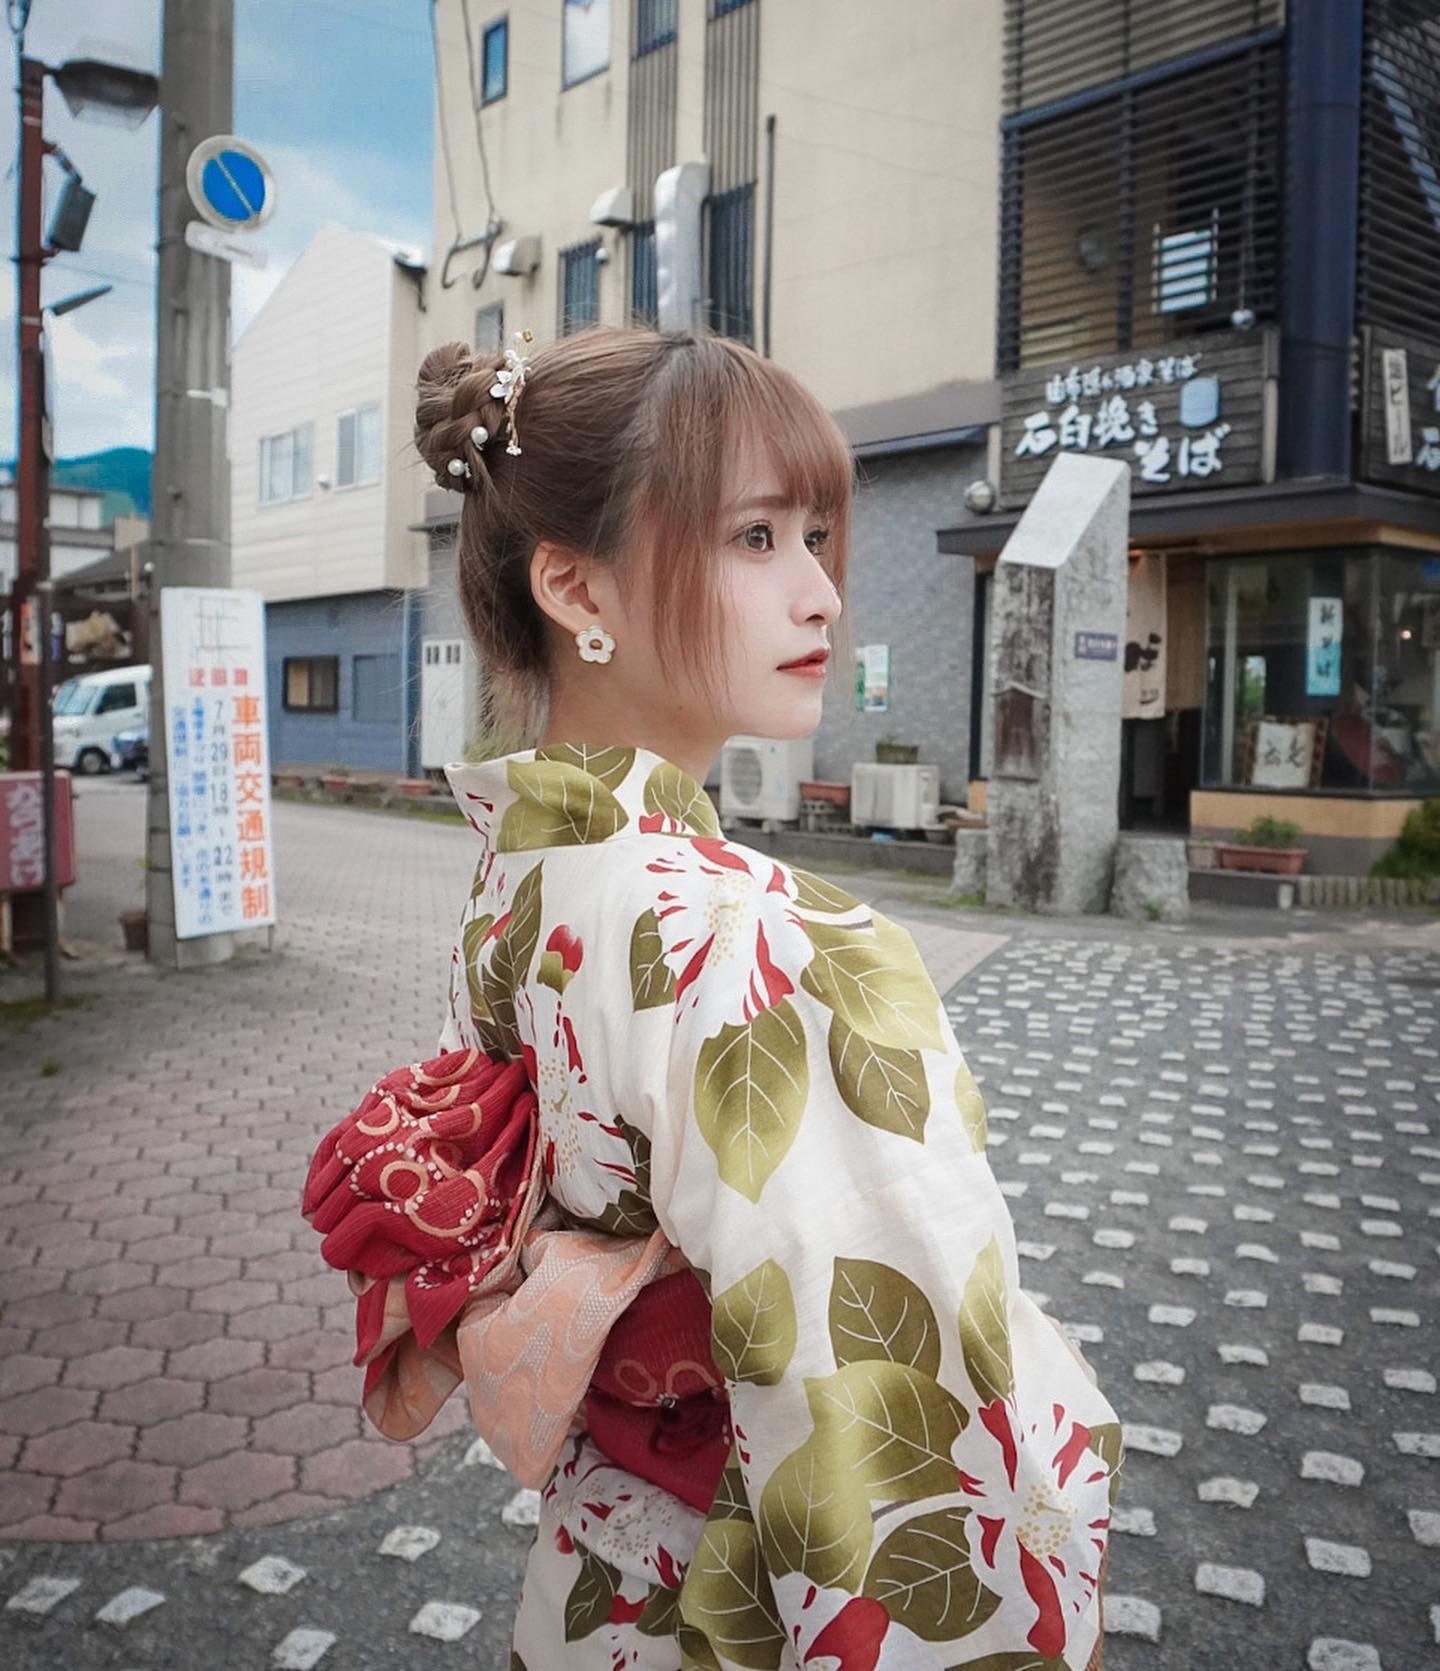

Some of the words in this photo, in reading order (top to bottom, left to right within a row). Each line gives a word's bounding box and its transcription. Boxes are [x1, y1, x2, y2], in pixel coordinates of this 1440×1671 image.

[1133, 422, 1231, 483] そば
[232, 693, 269, 919] 車両交通規制
